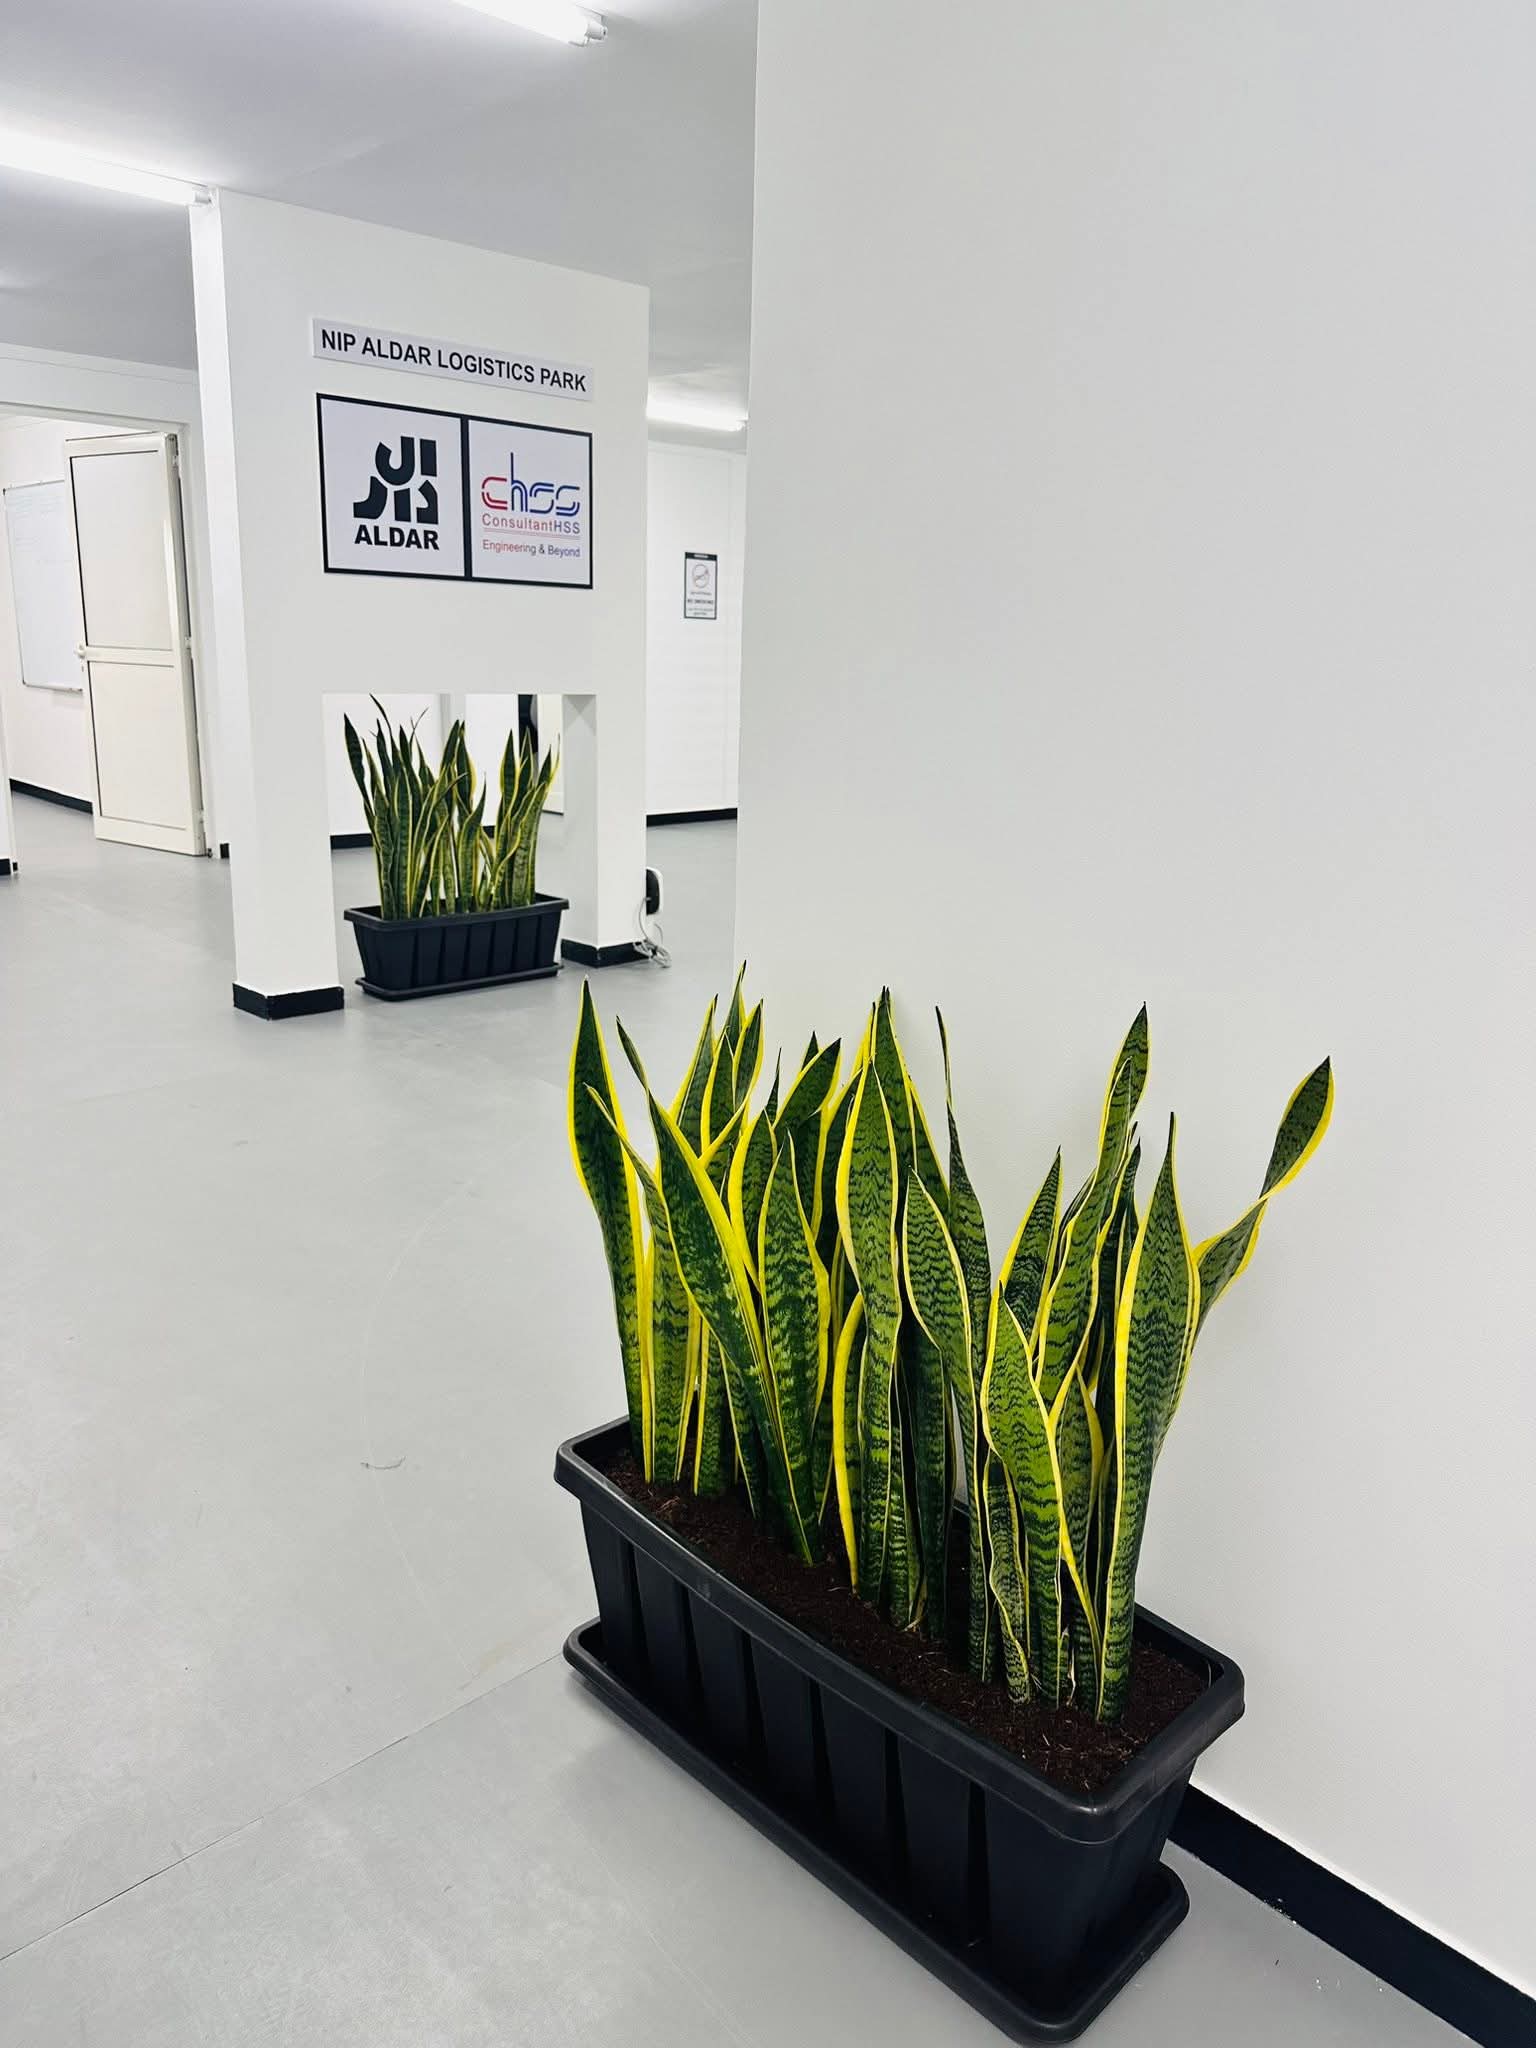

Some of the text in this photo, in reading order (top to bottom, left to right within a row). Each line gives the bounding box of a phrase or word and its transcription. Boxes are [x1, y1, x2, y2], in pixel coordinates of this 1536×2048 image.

[321, 328, 586, 392] NIP ALDAR LOGISTICS PARK
[482, 513, 581, 535] ConsultantHSS
[354, 524, 439, 550] ALDAR
[482, 539, 581, 559] Engineering & Beyond
